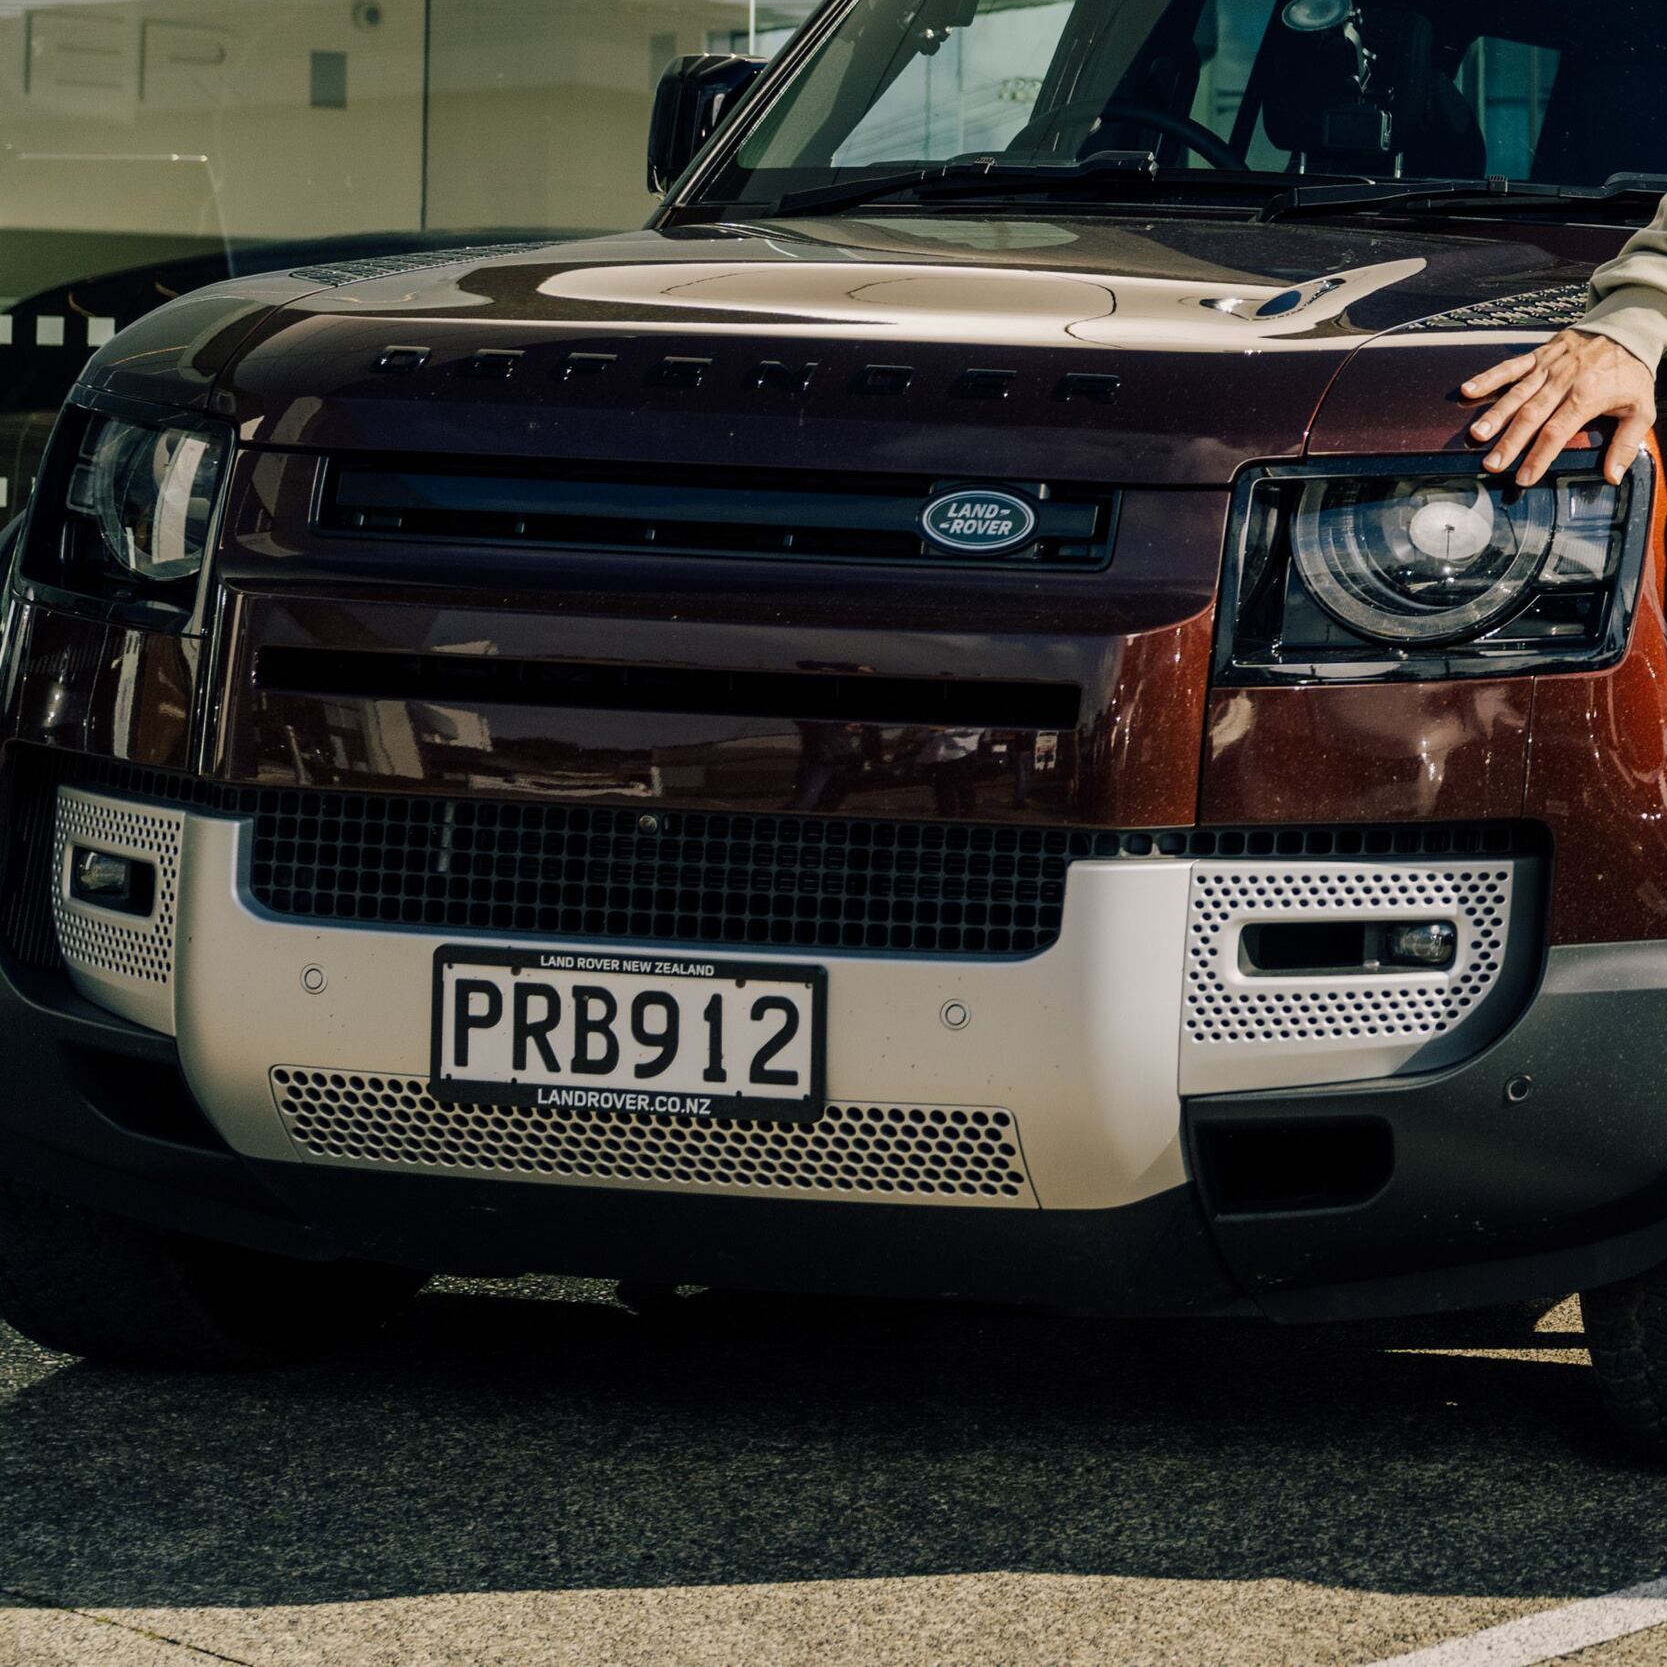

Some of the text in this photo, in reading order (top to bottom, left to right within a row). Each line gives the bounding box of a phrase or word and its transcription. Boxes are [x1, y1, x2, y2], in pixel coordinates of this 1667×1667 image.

[373, 343, 1120, 405] DEFENDER
[947, 502, 999, 519] LAND
[949, 518, 1013, 536] ROVER
[540, 954, 715, 977] LAND ROVER NEW ZEALAND
[453, 977, 800, 1087] PRB912
[537, 1087, 712, 1117] LANDROVER.CO.NZ
